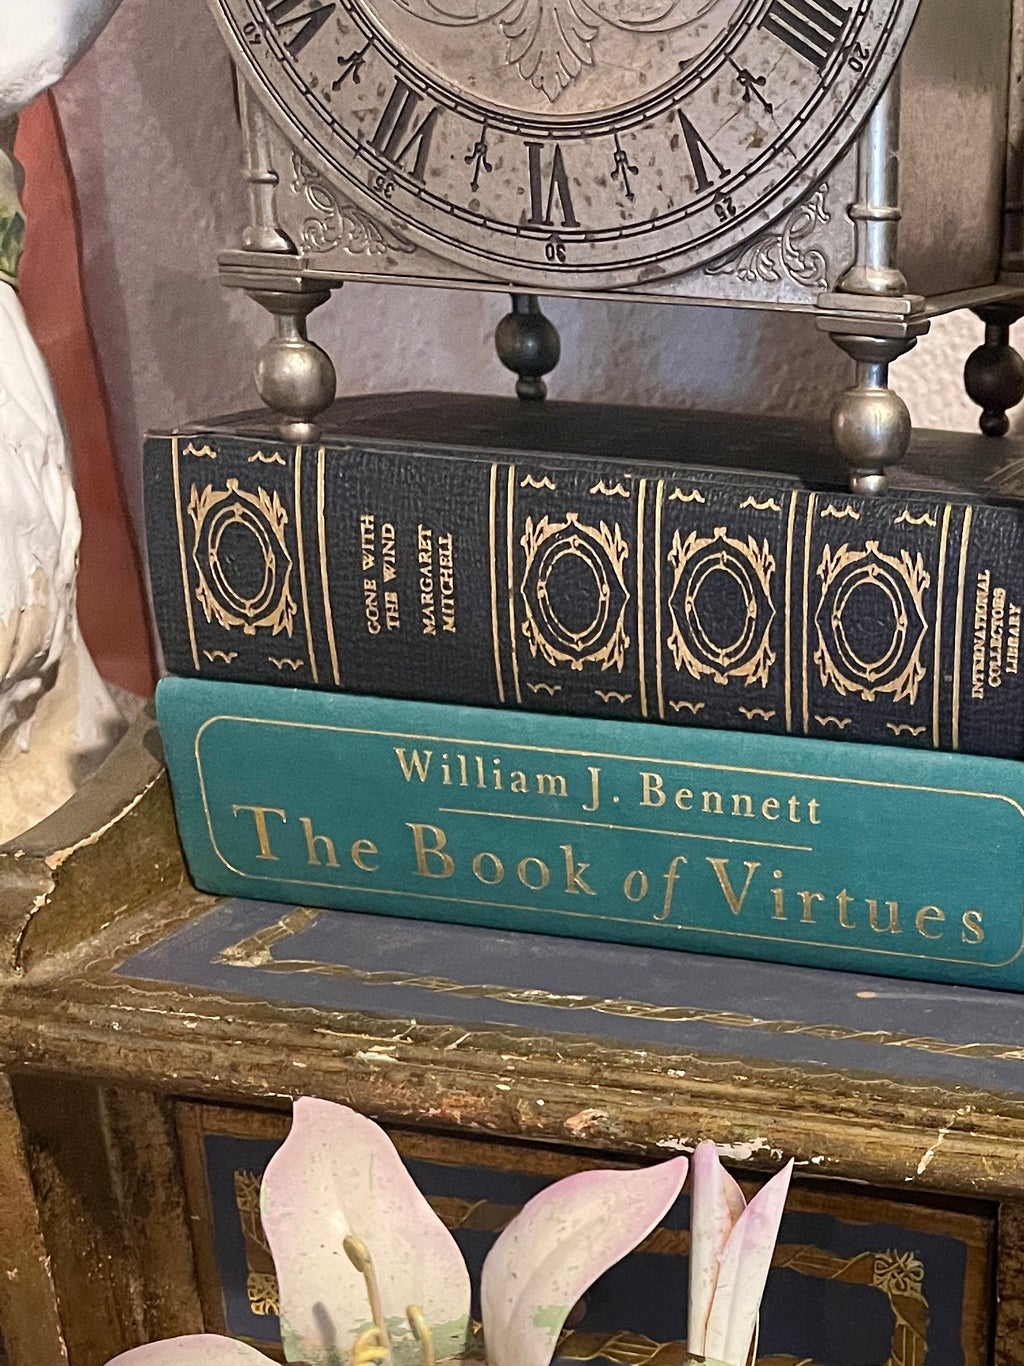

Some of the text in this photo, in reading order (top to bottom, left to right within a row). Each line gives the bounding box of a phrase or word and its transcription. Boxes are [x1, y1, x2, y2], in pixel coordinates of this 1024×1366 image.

[848, 41, 870, 72] 20
[366, 75, 439, 185] VII
[679, 108, 731, 194] V
[523, 141, 581, 227] VI
[360, 513, 381, 635] GONE WITH
[381, 523, 400, 631] THE WIND
[417, 523, 436, 636] MARGARET
[438, 532, 456, 633] MITCHELL
[971, 569, 991, 700] INTERNATIONAL
[988, 587, 1006, 688] COLLECTORS
[1005, 602, 1021, 674] LIBRARY
[393, 747, 821, 825] William J. Bennett
[232, 804, 985, 944] The Book of Virtues
